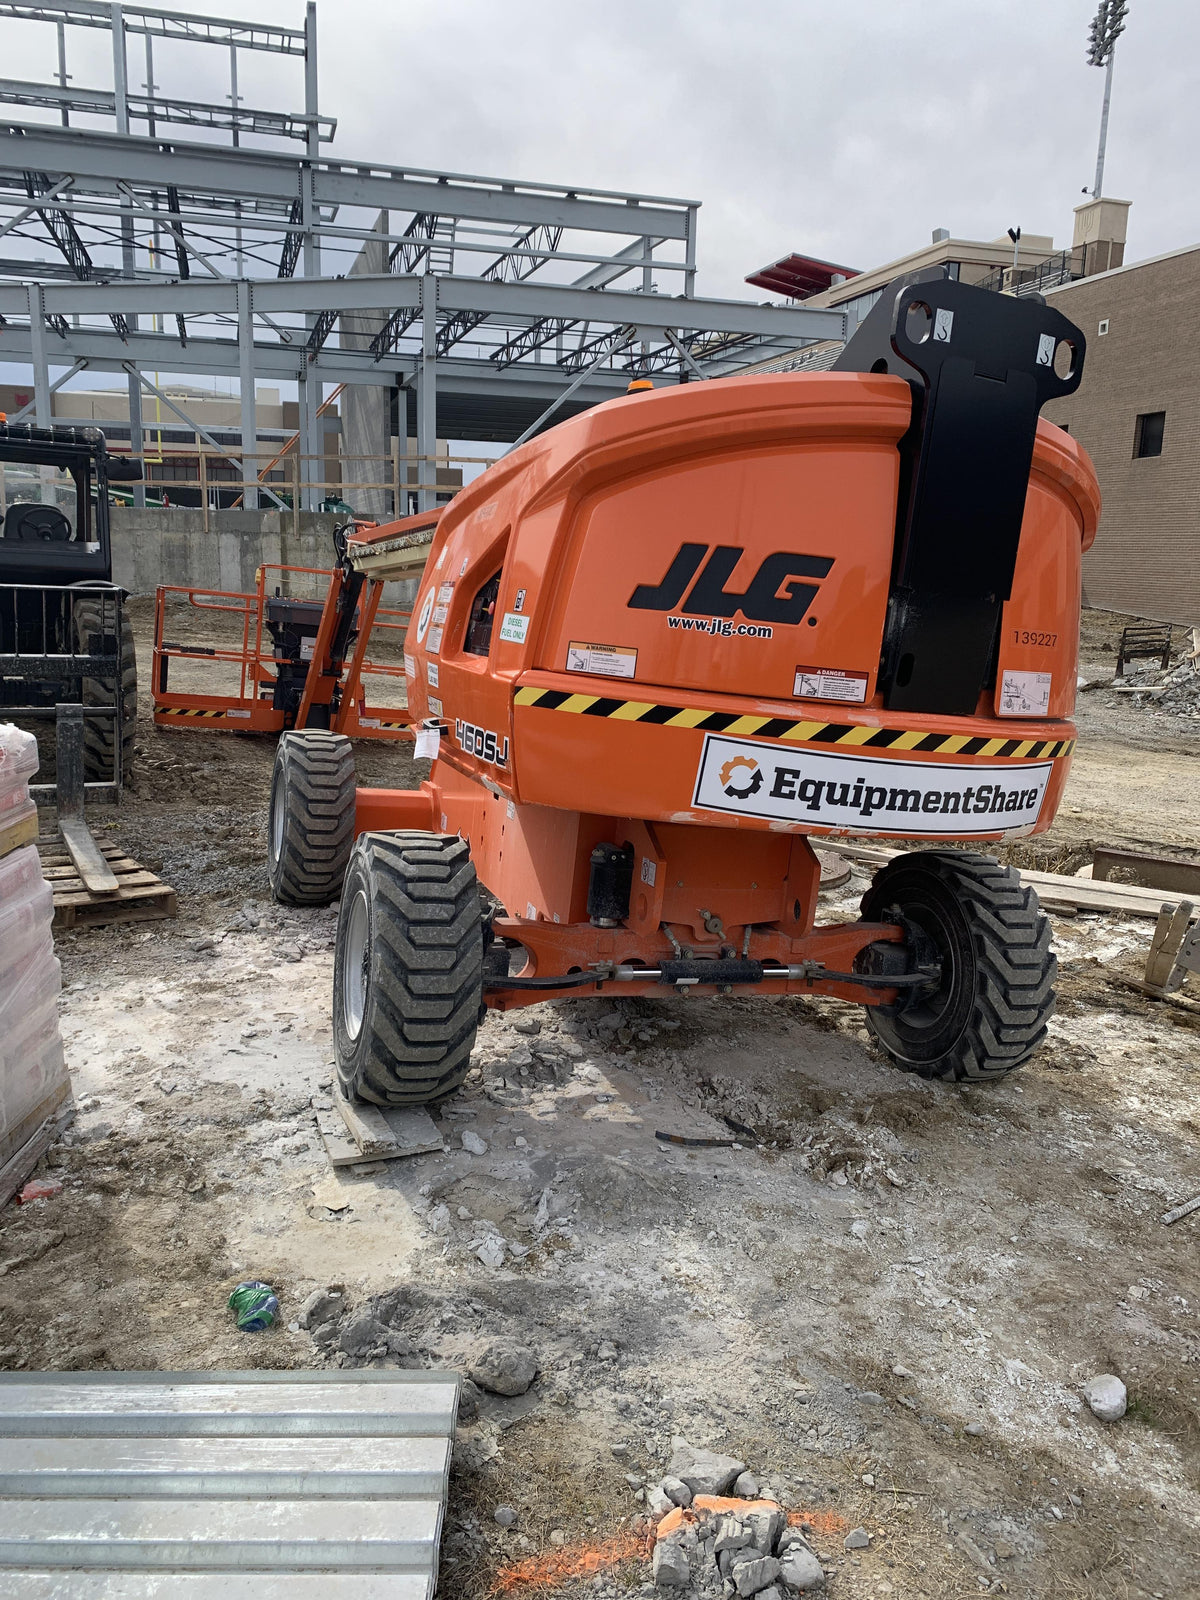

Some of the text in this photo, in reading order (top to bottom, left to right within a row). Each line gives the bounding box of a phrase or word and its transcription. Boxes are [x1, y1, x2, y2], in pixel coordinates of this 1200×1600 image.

[508, 617, 522, 628] DIESEL
[667, 616, 773, 638] www.jlg.com
[501, 628, 525, 640] FUEL ONLY
[1013, 630, 1058, 647] 139227
[591, 645, 617, 653] WARNING
[821, 669, 846, 677] DANGER
[456, 718, 509, 769] 460SJ
[769, 767, 1038, 817] EquipmentShare
